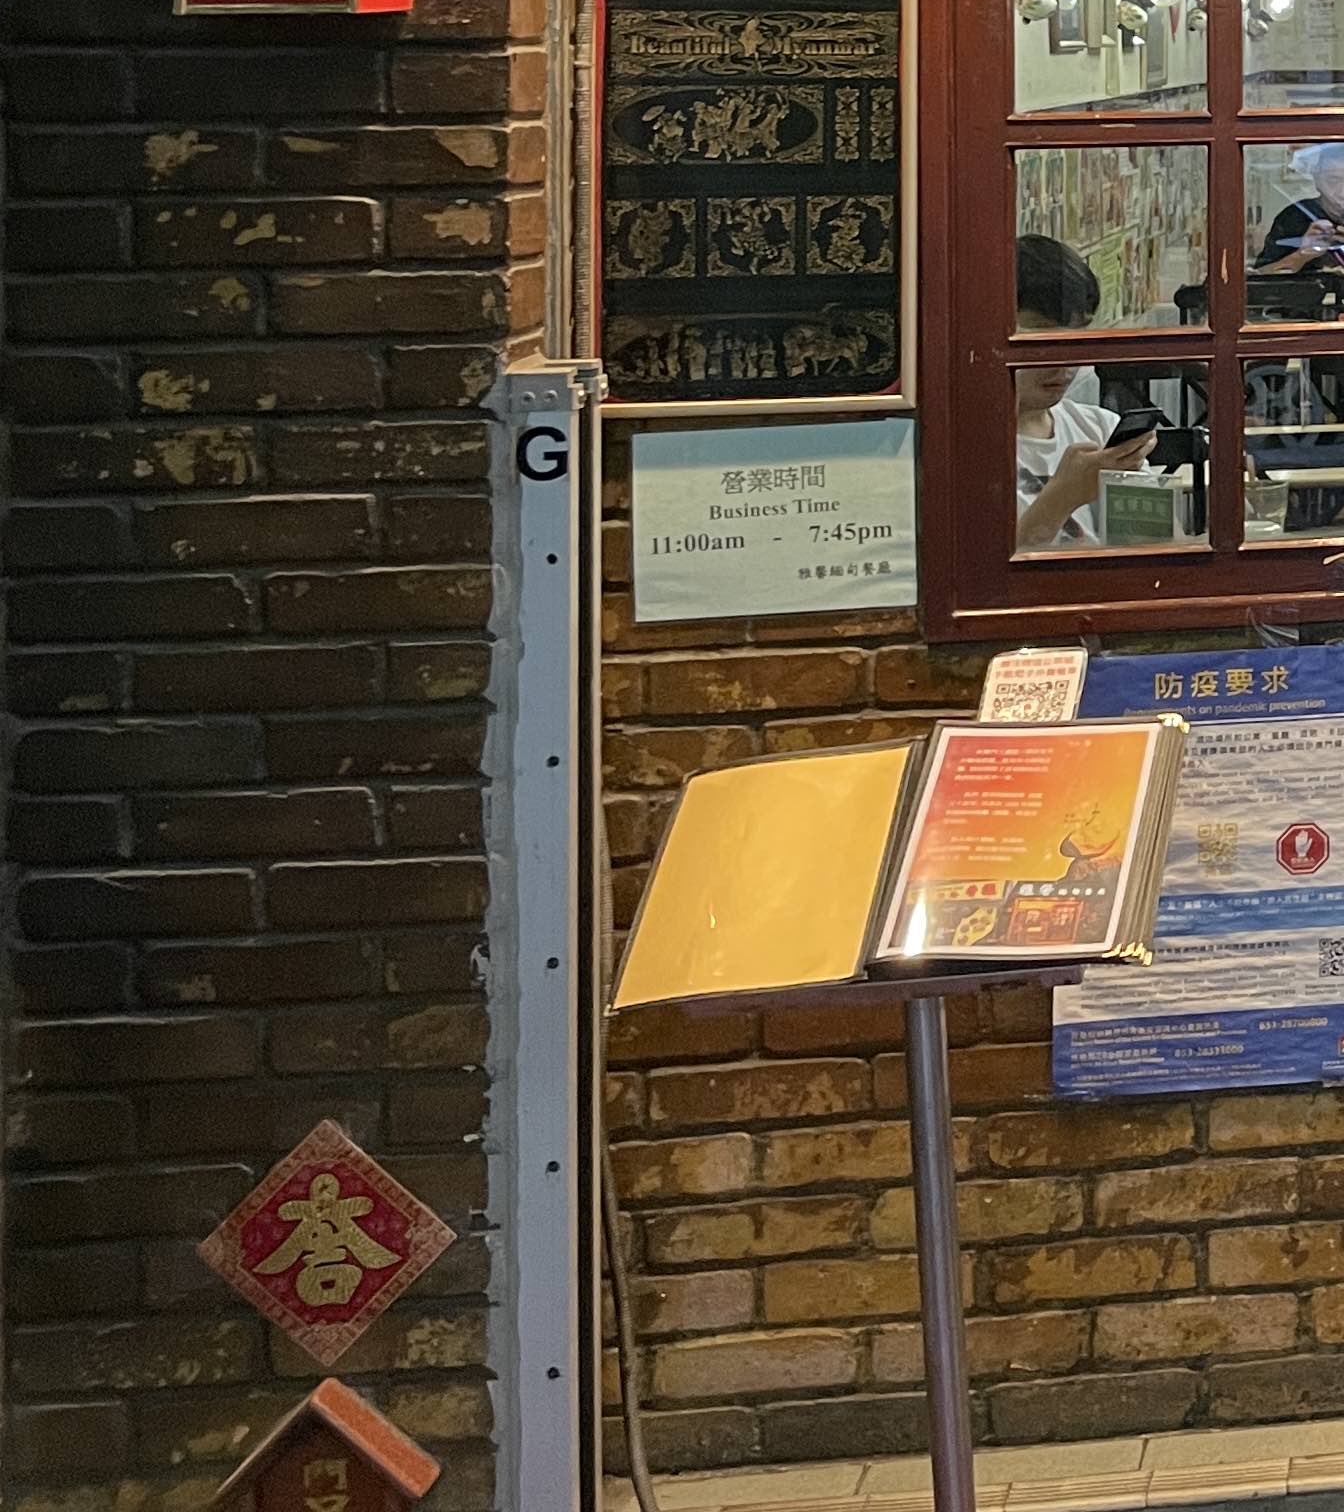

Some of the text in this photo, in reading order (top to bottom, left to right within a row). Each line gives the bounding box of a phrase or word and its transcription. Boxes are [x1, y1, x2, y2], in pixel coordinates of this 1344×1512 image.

[515, 425, 569, 482] G
[720, 464, 827, 496] 營業時間
[708, 498, 841, 521] Business Time
[650, 533, 746, 556] 11:00am
[808, 522, 893, 545] 7:45pm
[1154, 666, 1290, 701] 防疫要求
[252, 1172, 403, 1308] 春
